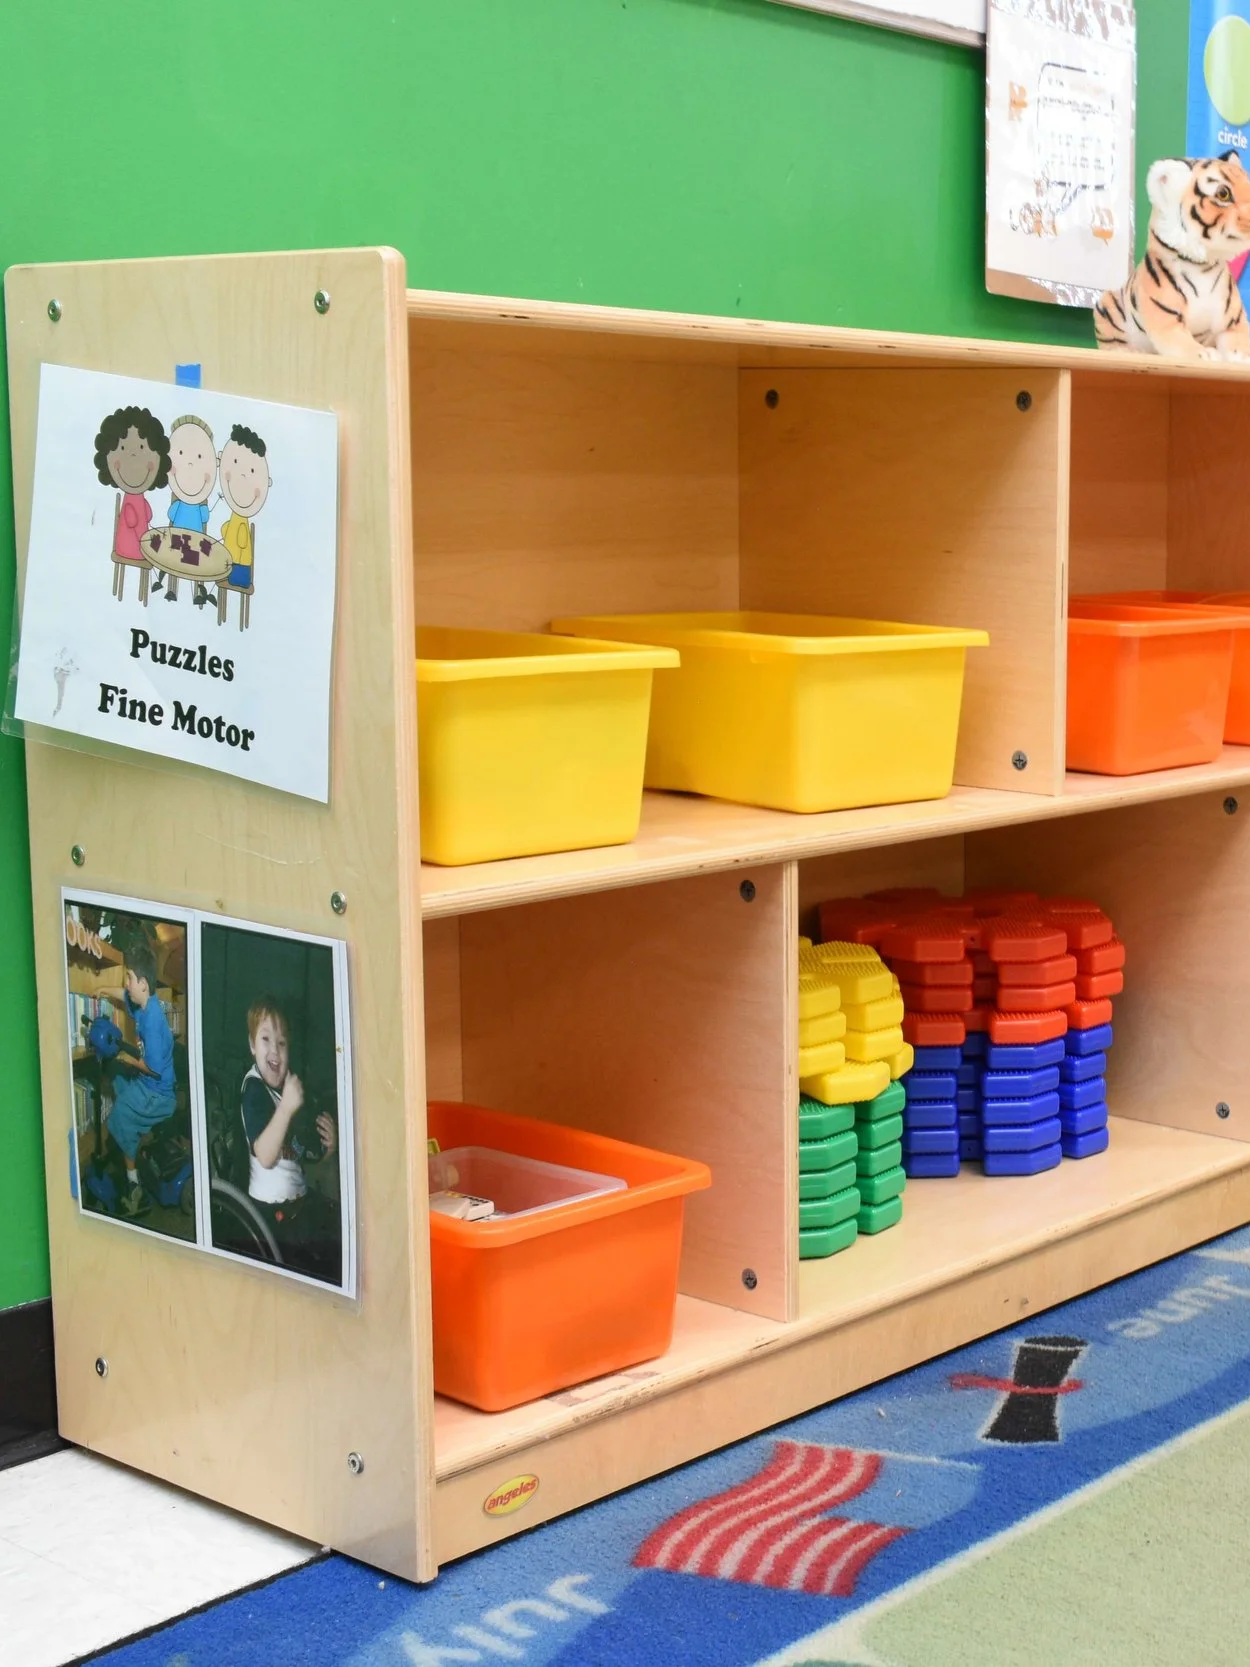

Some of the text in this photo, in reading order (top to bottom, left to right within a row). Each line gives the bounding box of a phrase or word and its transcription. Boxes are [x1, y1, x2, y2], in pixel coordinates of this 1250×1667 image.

[1217, 127, 1248, 149] circle
[130, 628, 235, 682] Puzzles
[98, 683, 255, 751] Fine Motor
[486, 1479, 538, 1510] angeles
[400, 1573, 617, 1667] July
